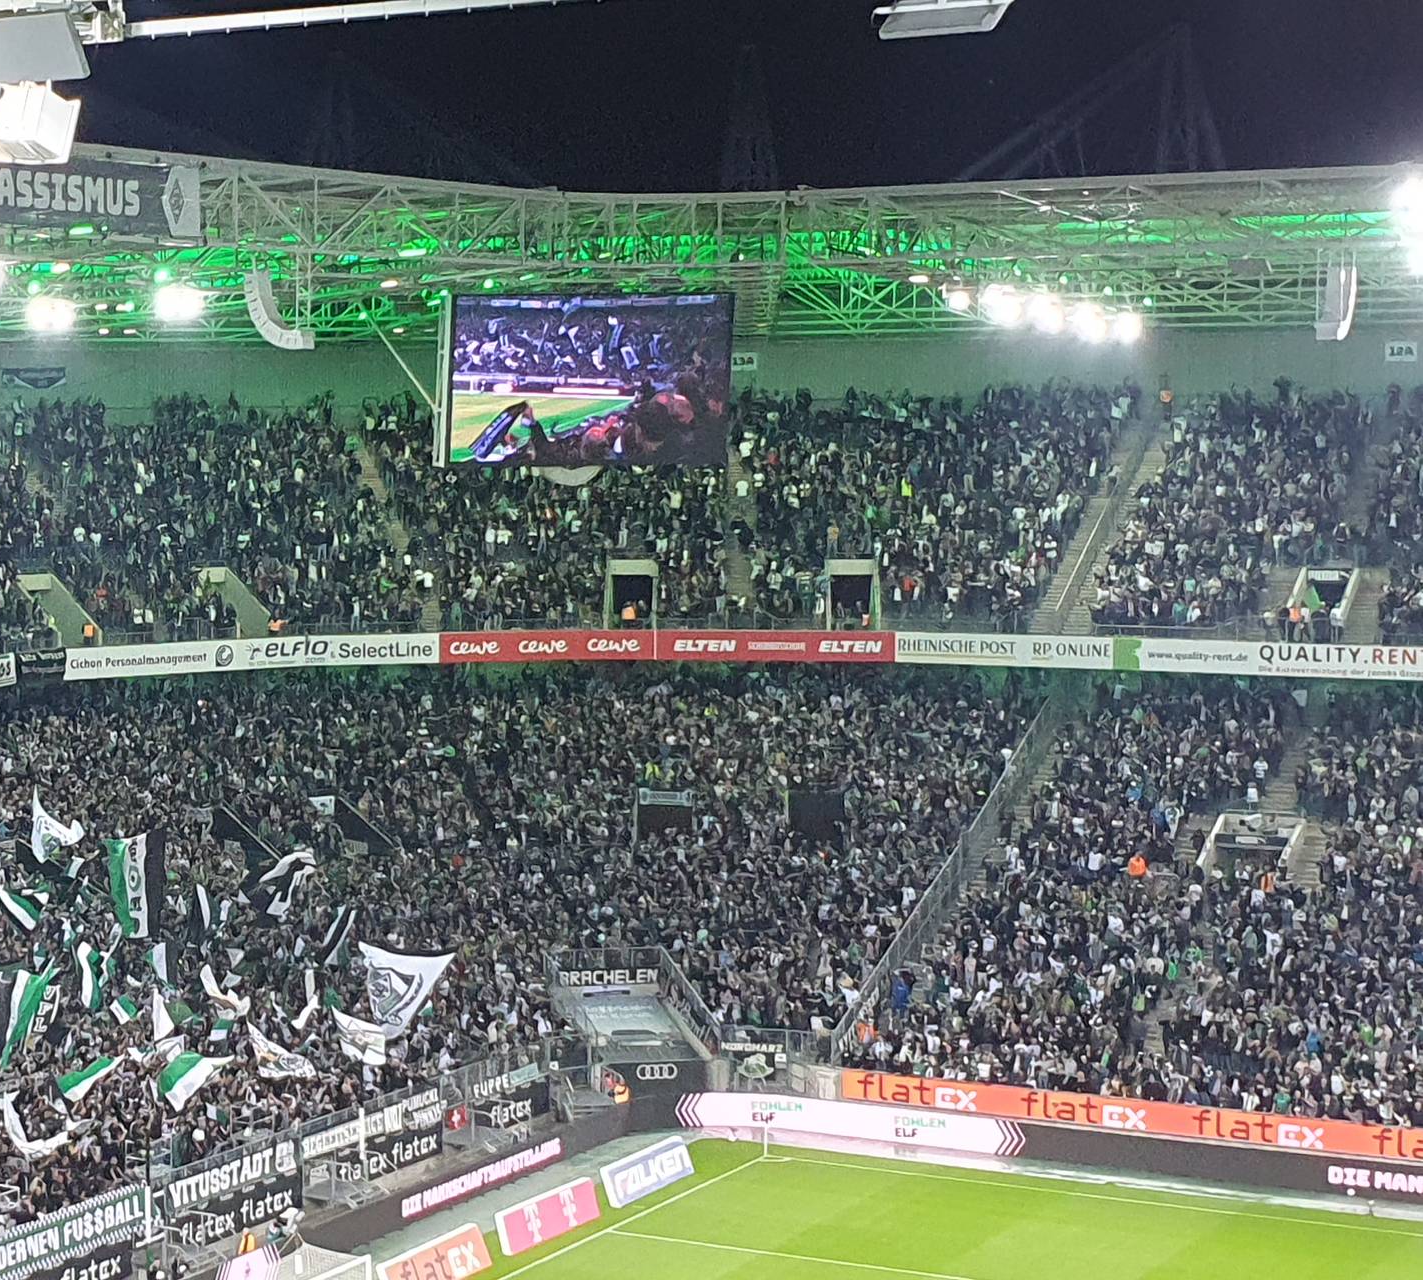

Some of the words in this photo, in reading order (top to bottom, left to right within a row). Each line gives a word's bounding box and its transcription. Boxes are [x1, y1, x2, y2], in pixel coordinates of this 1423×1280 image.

[338, 641, 433, 659] SelectLine
[448, 637, 500, 656] cewe
[518, 637, 568, 654] cewe
[587, 636, 641, 653] cewe
[673, 639, 737, 652] ELTEN
[818, 640, 882, 653] ELTEN
[897, 638, 977, 654] RHEINISCHE
[980, 640, 1017, 655] POST
[1032, 641, 1053, 656] RP
[1056, 642, 1111, 658] ONLINE
[1259, 644, 1423, 665] QUALITY.REN
[70, 657, 103, 669] Cichon
[105, 653, 208, 668] Personalmanagement
[559, 968, 658, 986] BRACHELEN
[751, 1101, 802, 1112] FOHLEN
[894, 1116, 946, 1128] FOHLEN
[895, 1128, 918, 1137] ELF
[169, 1147, 274, 1209] VITUSSTADT
[614, 1149, 689, 1200] FALKEN
[1328, 1165, 1370, 1188] DIE
